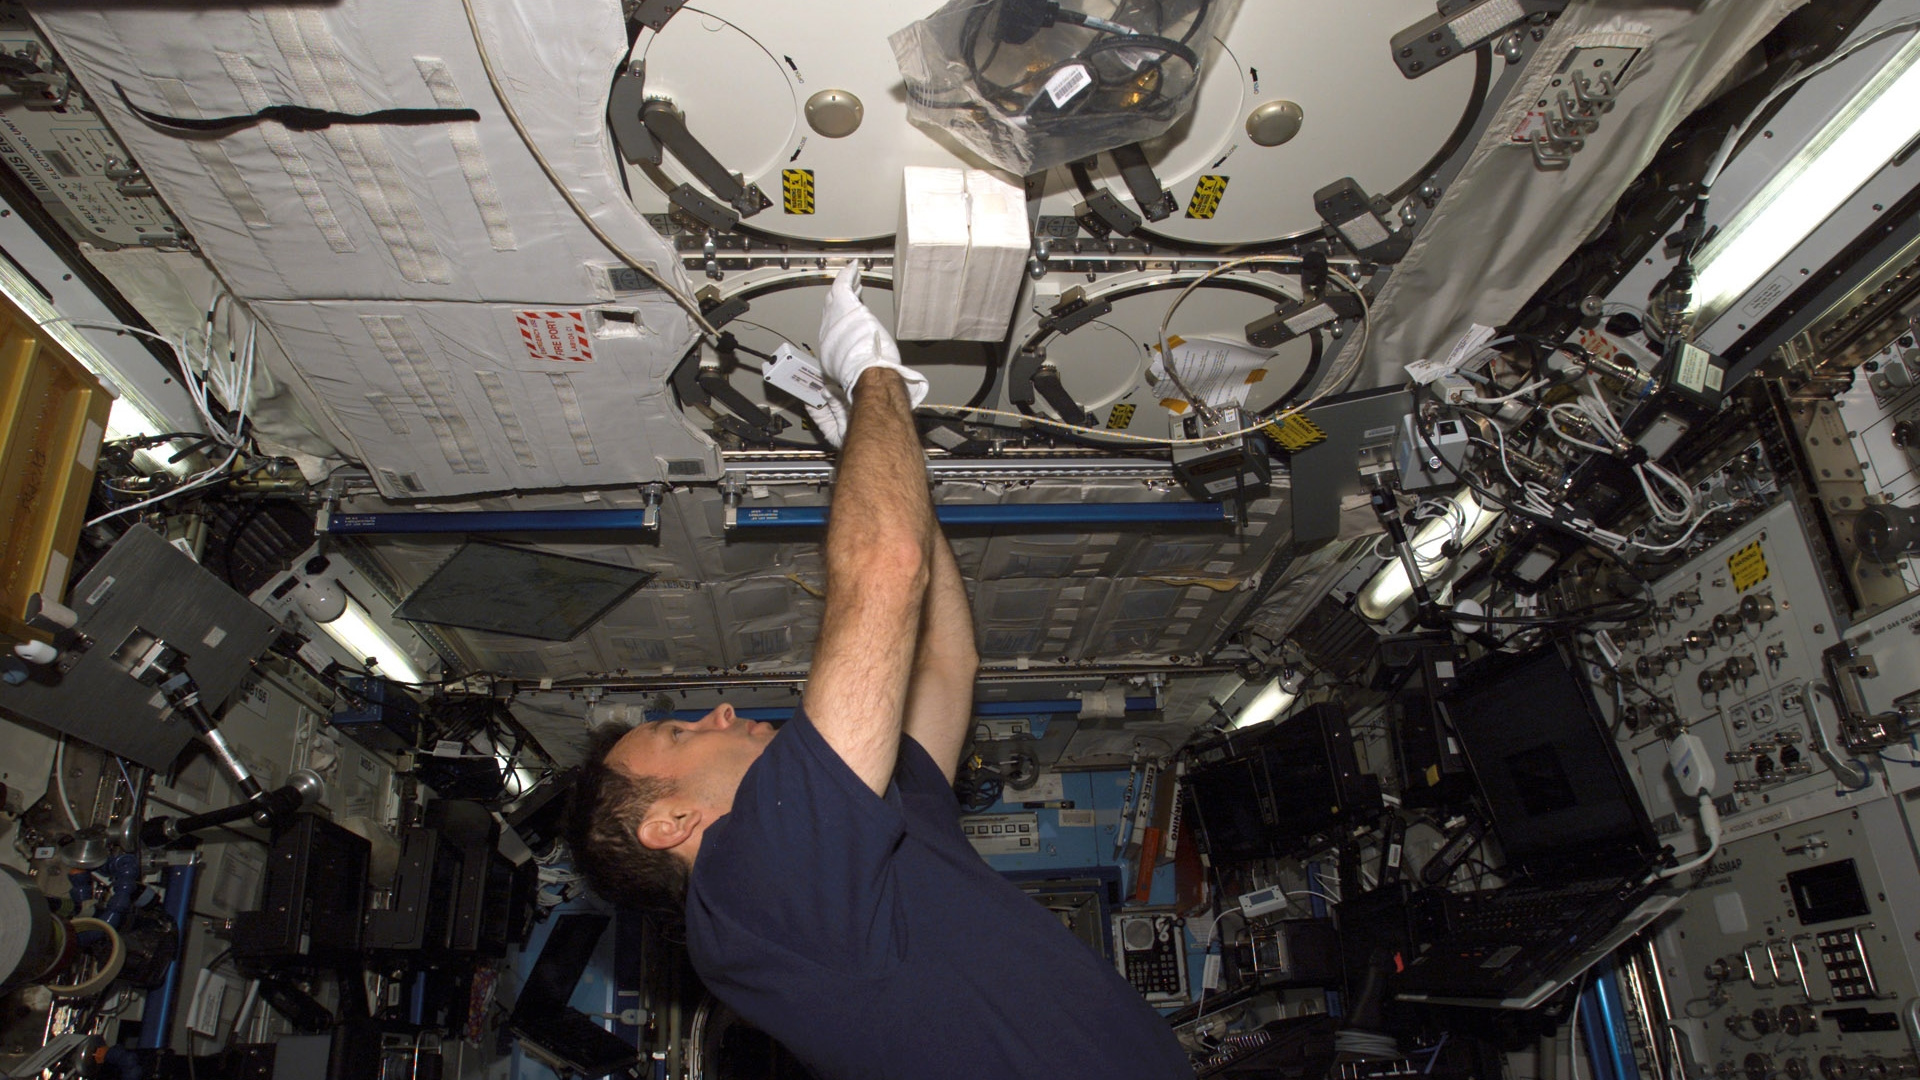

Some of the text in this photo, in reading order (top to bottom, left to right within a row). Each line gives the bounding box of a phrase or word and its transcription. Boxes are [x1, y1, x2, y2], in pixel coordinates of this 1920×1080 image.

[9, 155, 48, 191] MINUS
[18, 136, 61, 180] ELECTRONIC
[76, 204, 99, 224] MELFI
[546, 319, 565, 356] FIRE PORT
[1142, 766, 1156, 800] EMER
[1171, 789, 1184, 841] WARNING
